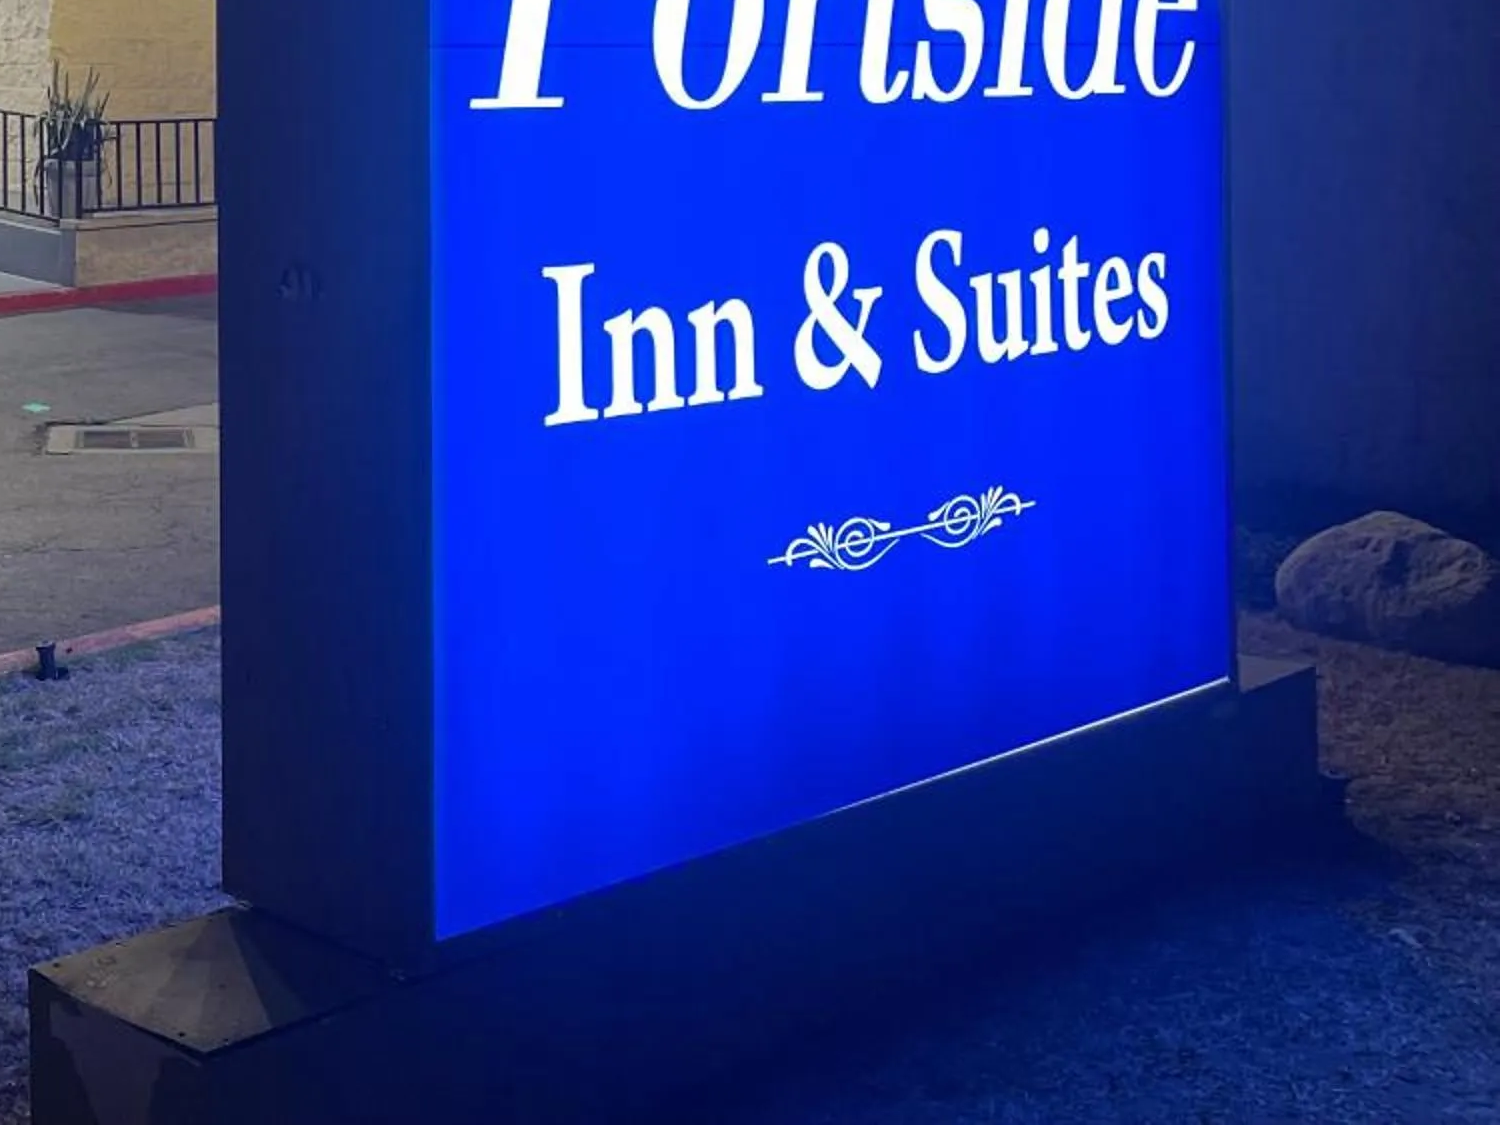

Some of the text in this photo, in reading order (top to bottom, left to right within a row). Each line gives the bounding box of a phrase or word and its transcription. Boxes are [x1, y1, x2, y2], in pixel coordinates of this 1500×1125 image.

[541, 227, 1169, 427] Inn & Suites
